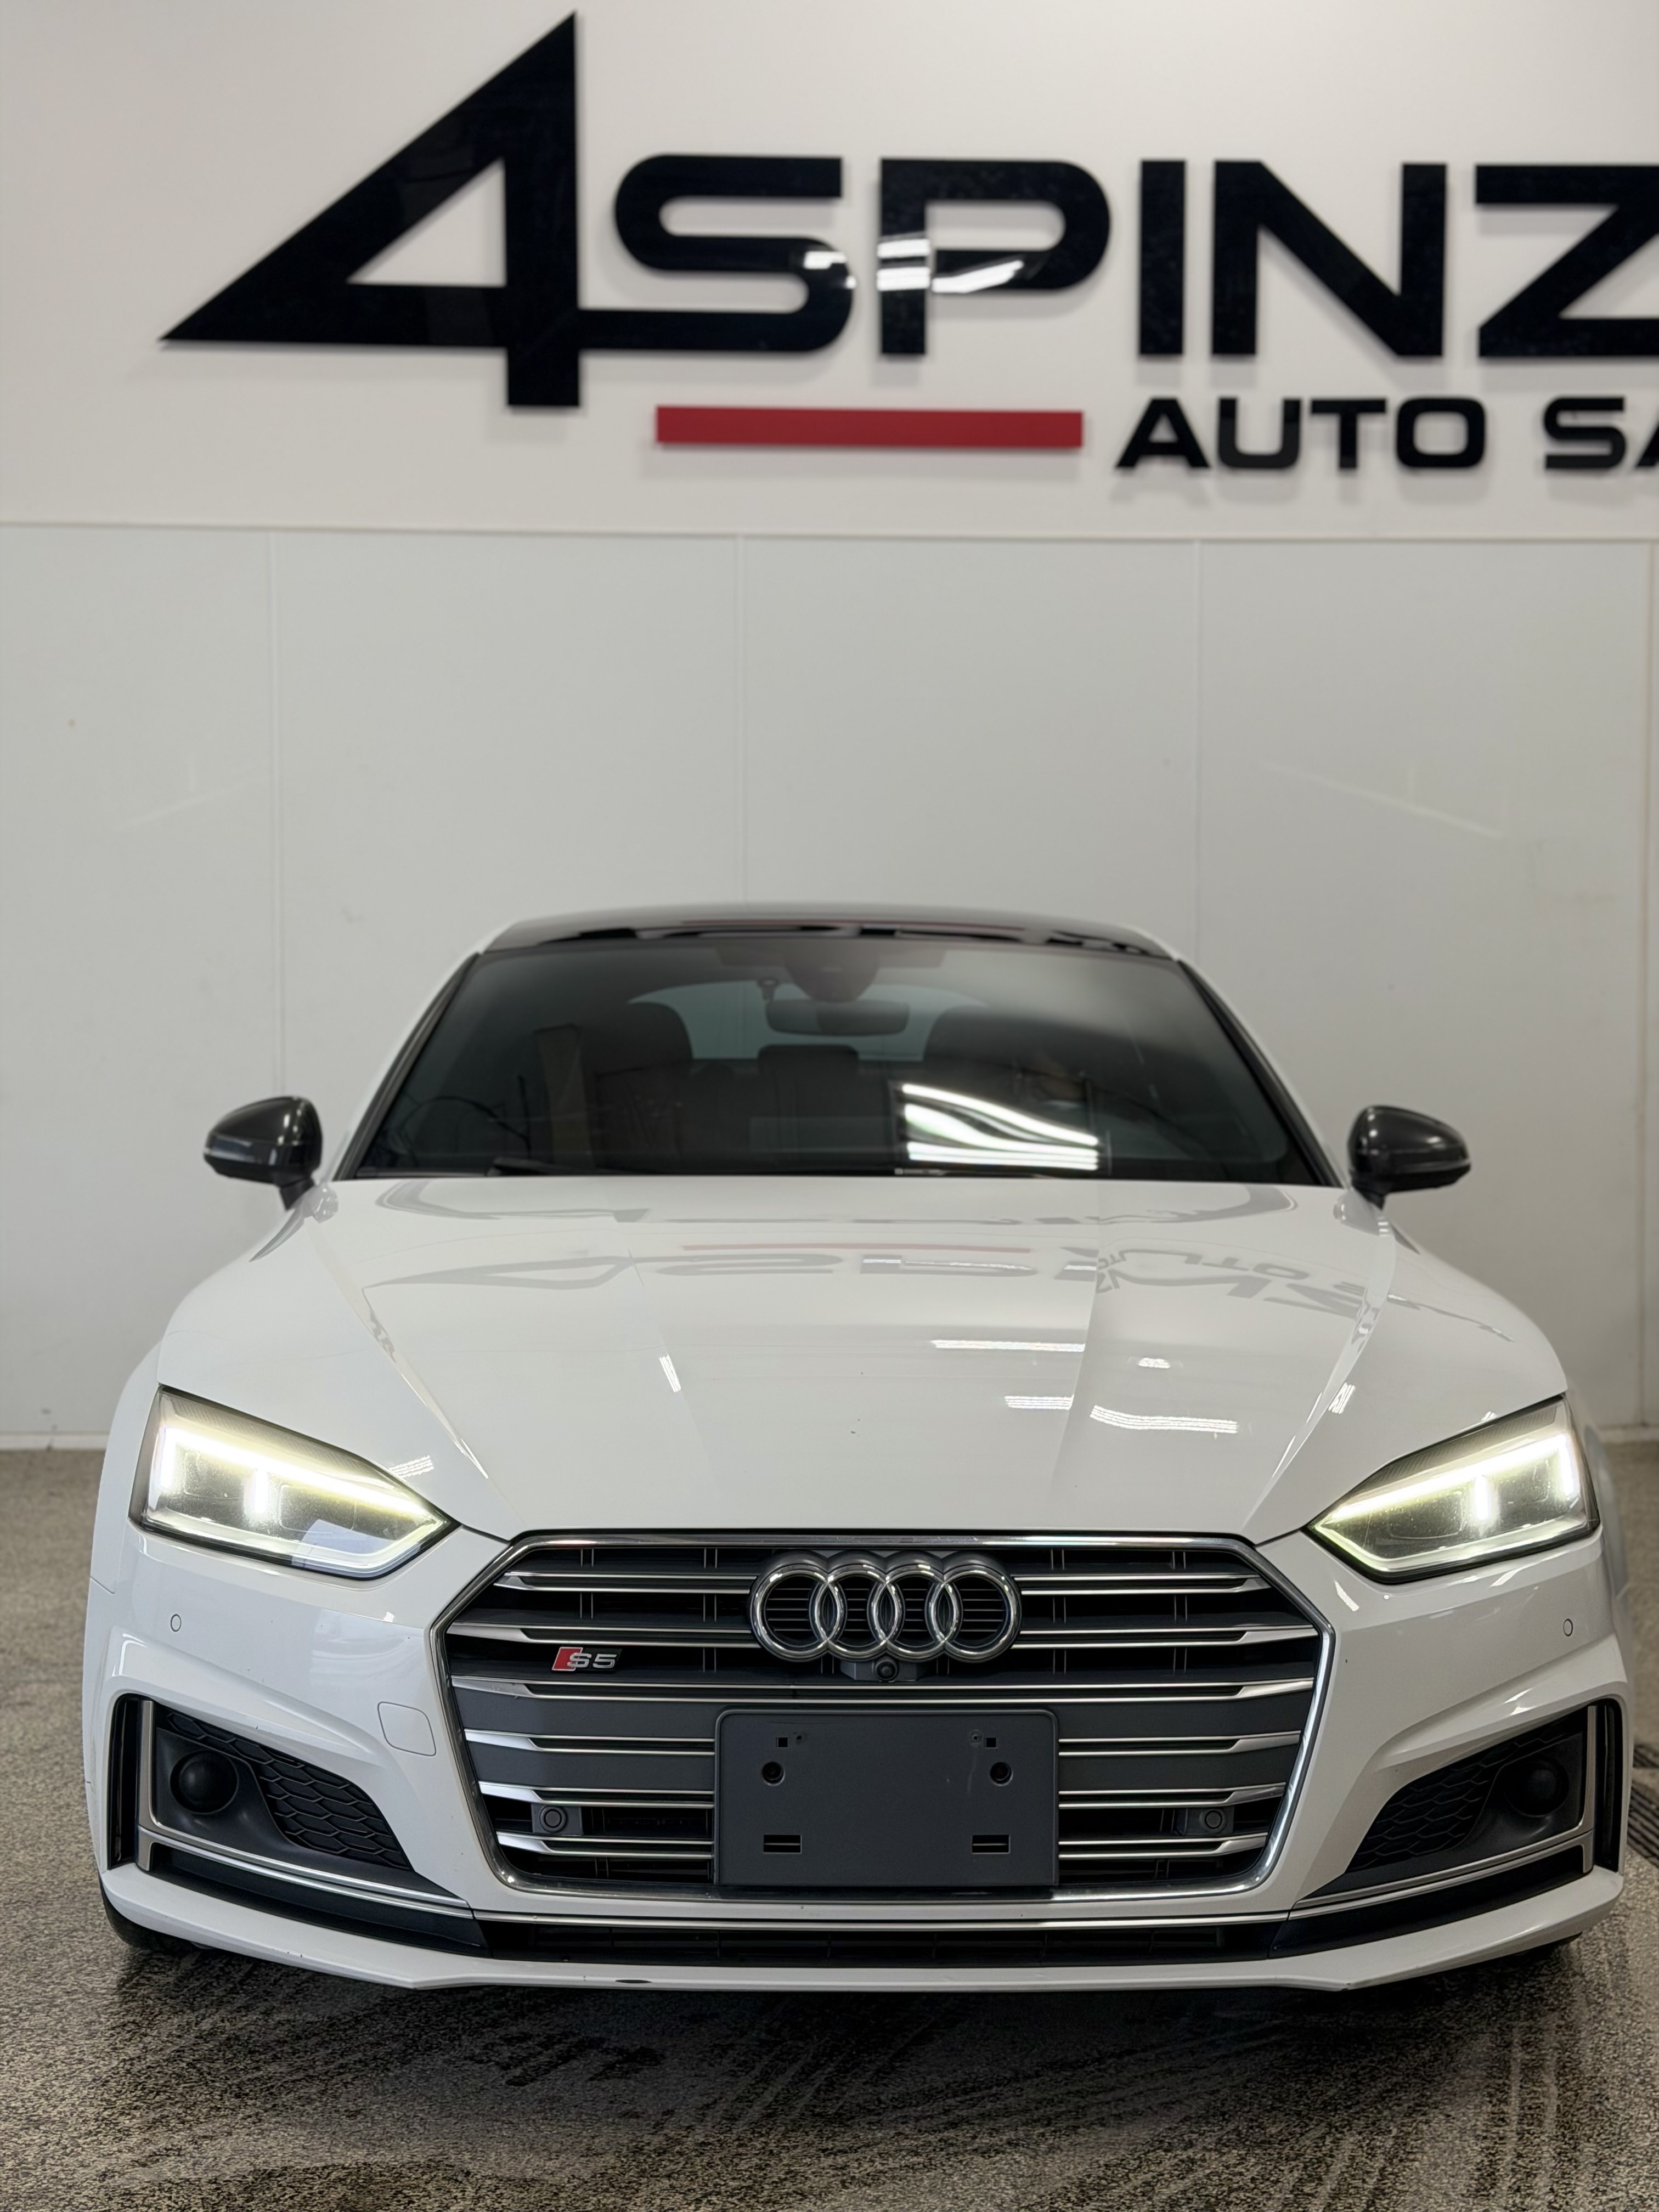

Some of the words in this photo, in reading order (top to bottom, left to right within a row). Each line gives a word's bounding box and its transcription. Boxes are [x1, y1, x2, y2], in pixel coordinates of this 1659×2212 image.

[1115, 397, 1486, 470] AUTO
[1543, 396, 1659, 470] S
[567, 1652, 617, 1669] S5
